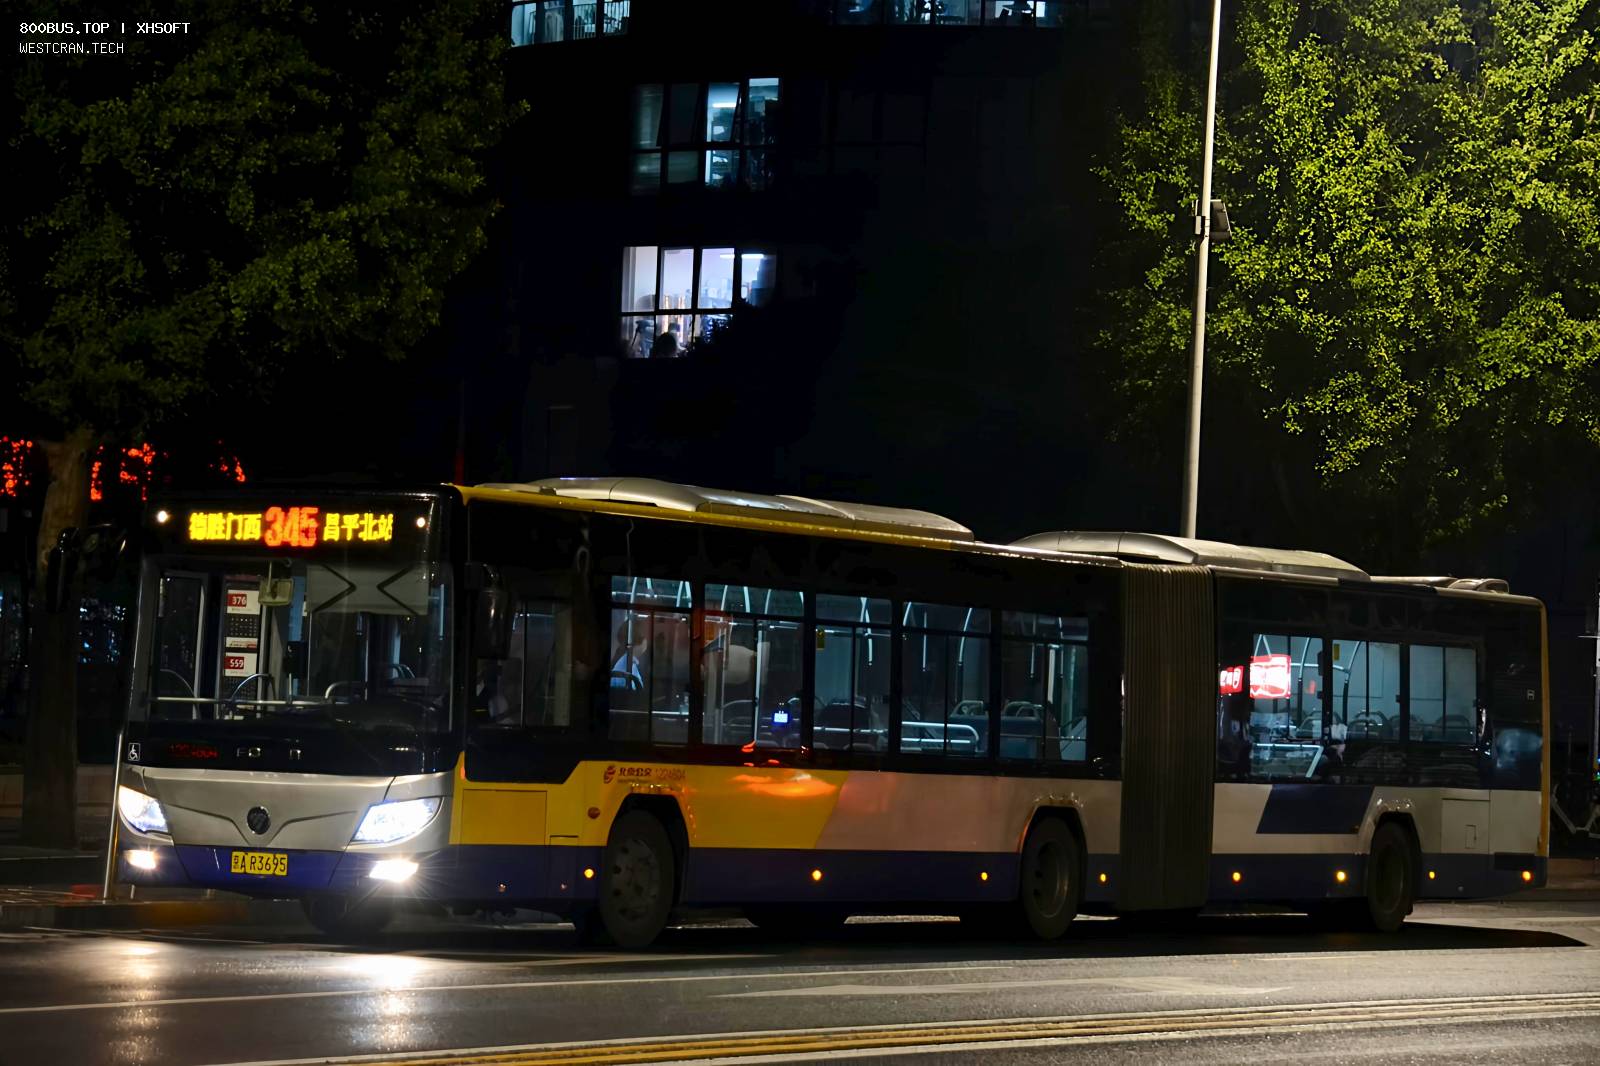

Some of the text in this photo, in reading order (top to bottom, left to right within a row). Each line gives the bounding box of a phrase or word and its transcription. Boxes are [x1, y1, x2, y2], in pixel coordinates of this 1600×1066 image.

[264, 506, 319, 547] 345
[323, 513, 394, 541] 昌平北站
[231, 596, 247, 607] 376
[230, 658, 244, 669] 559
